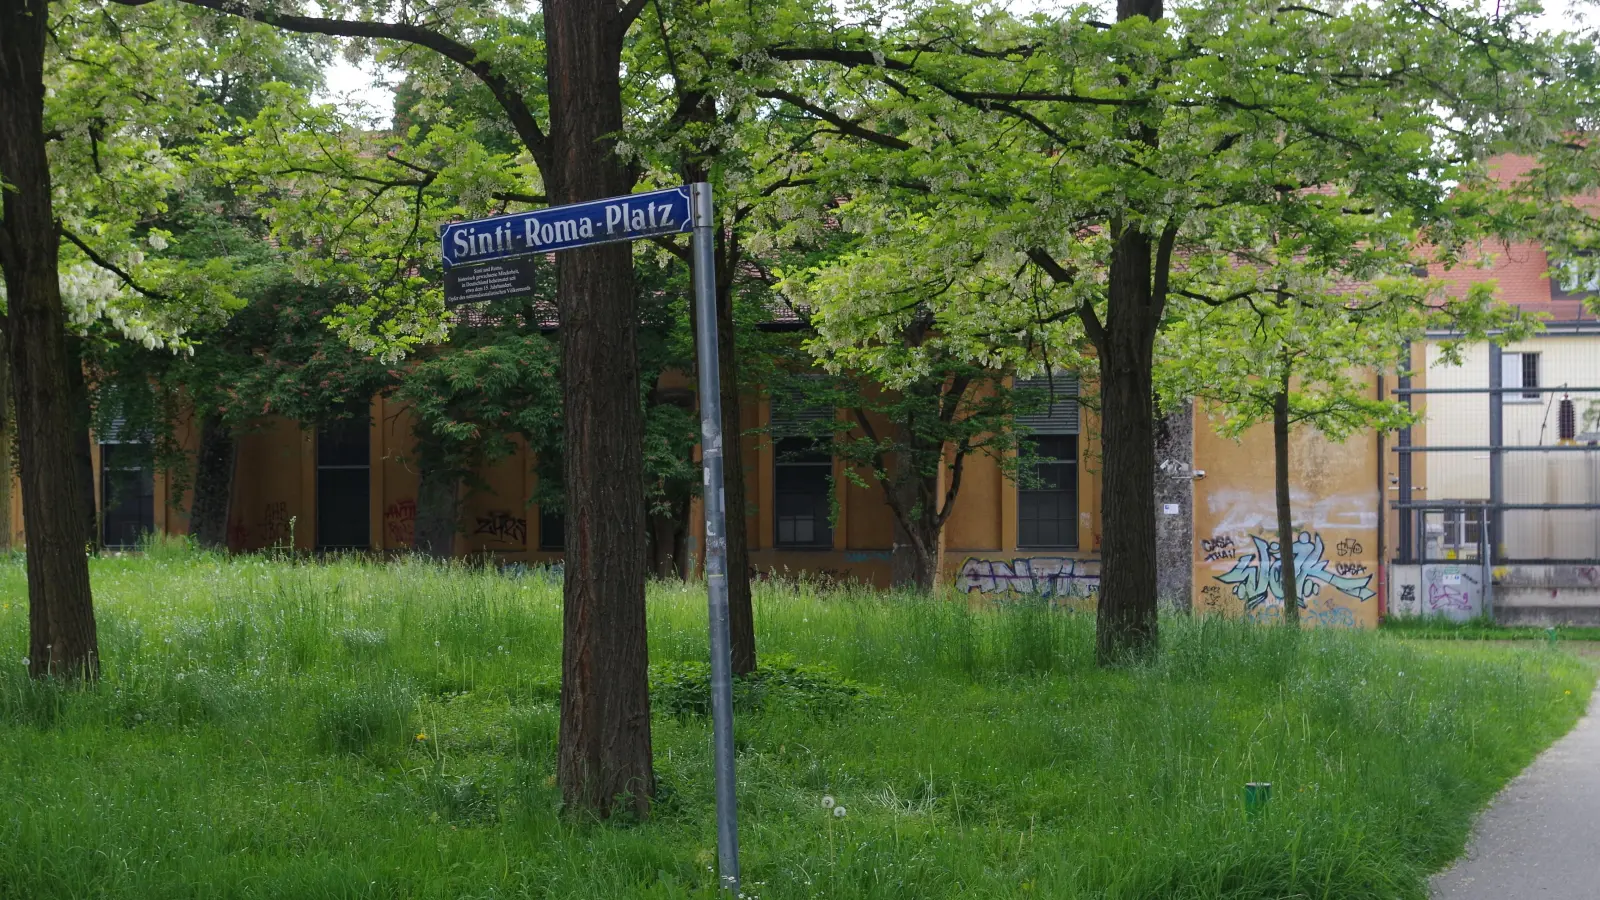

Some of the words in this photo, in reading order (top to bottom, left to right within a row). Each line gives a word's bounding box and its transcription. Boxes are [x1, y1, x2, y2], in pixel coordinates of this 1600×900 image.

[453, 201, 674, 259] Sinti-Roma-Platz
[457, 274, 475, 282] historisch
[466, 279, 488, 287] Deutschland
